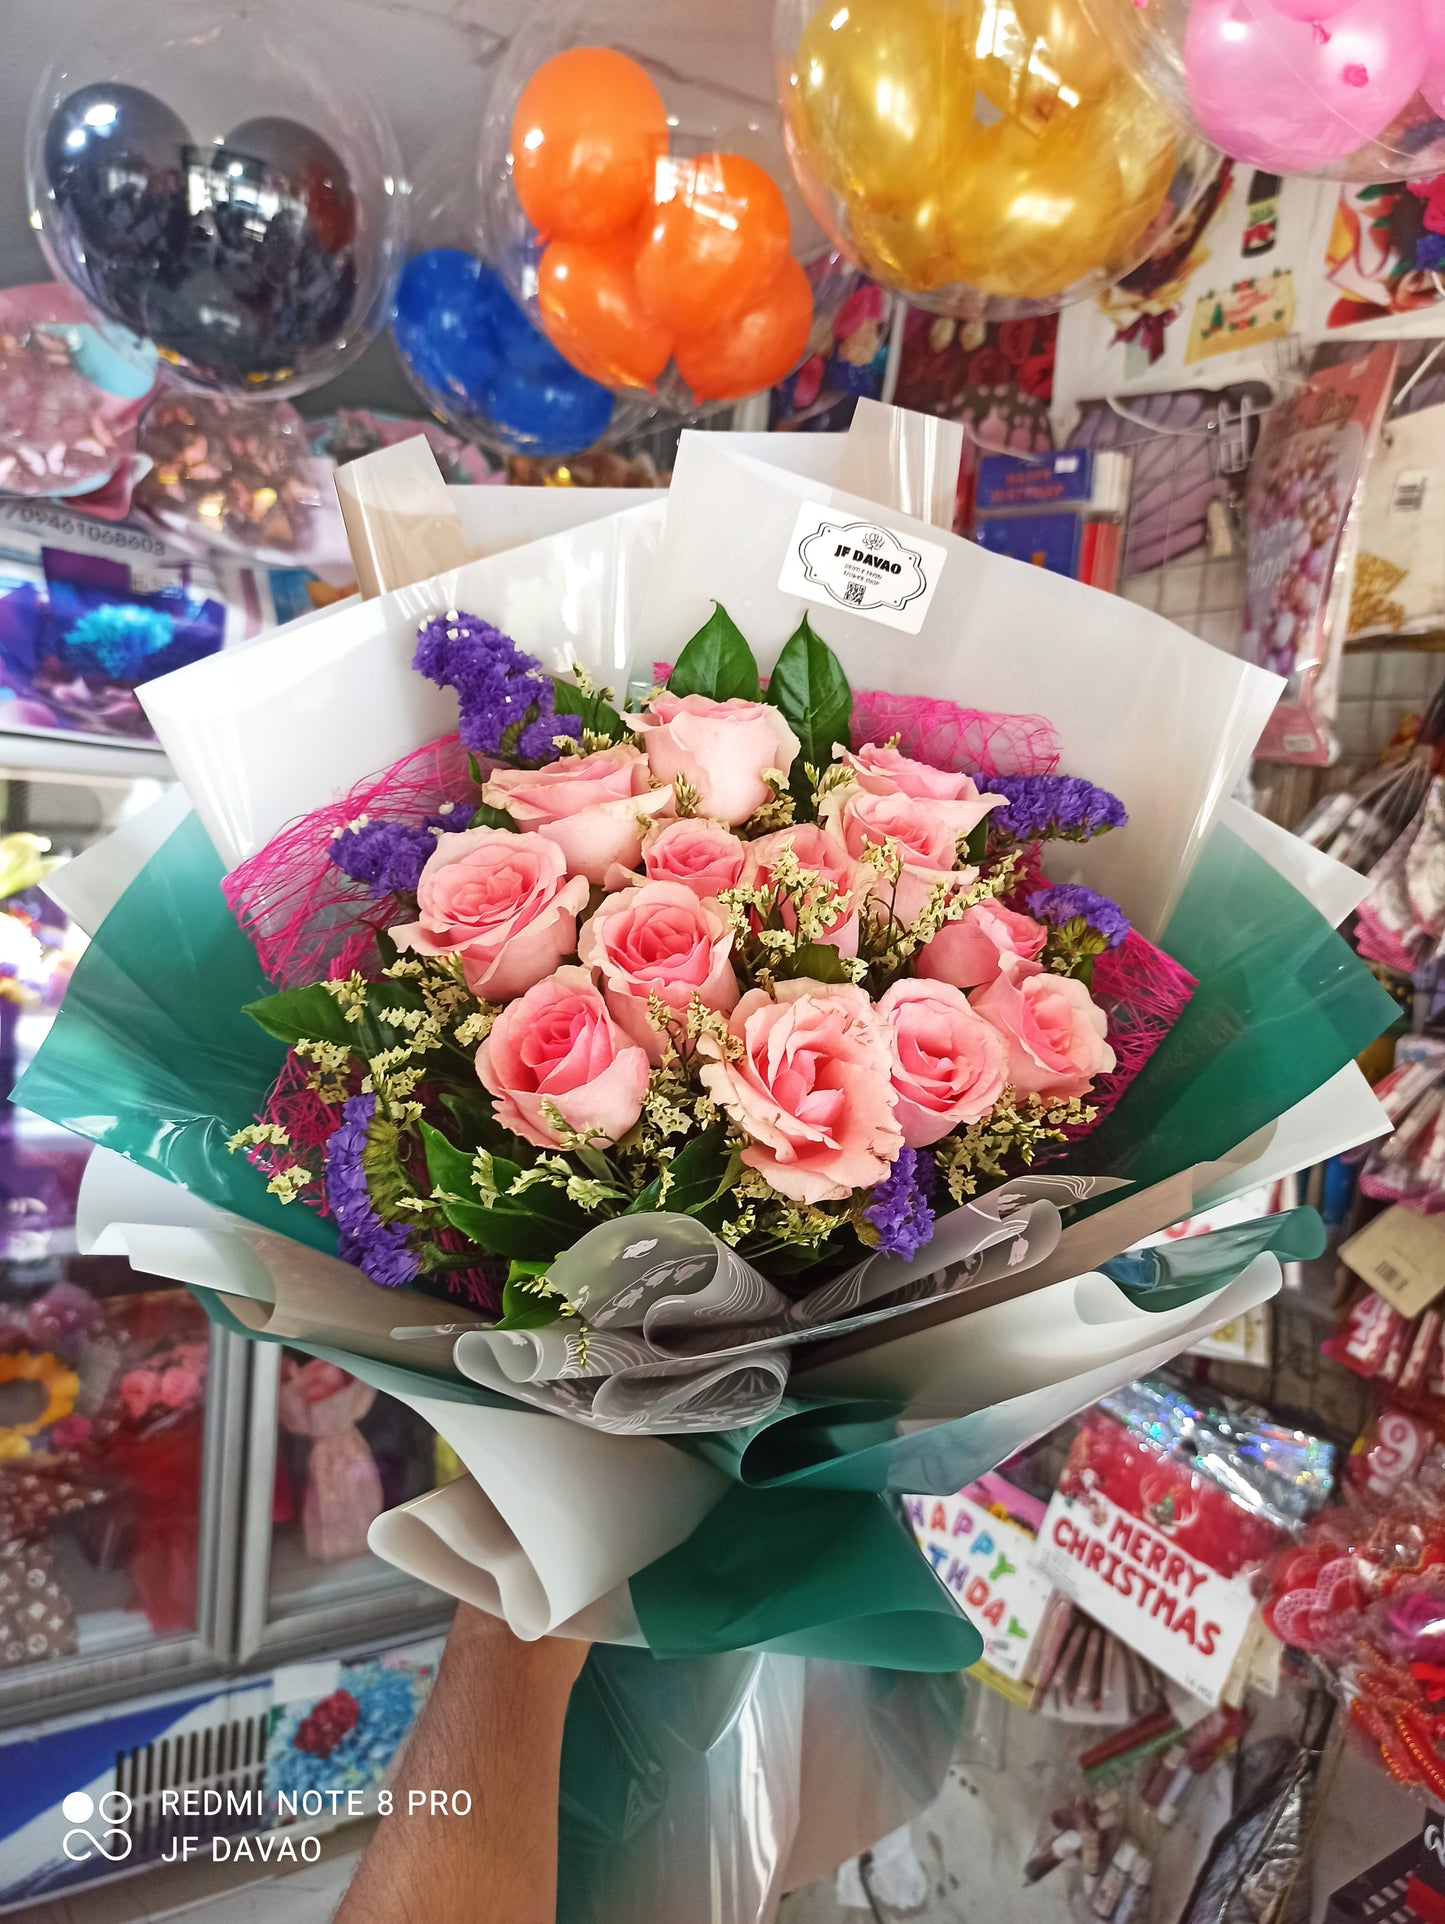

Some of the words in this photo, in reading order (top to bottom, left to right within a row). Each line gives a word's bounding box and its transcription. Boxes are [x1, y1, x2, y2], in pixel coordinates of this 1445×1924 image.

[834, 544, 851, 557] JF
[852, 549, 902, 575] DAVAO
[904, 1499, 1016, 1581] HAPPY
[1108, 1516, 1208, 1598] MERRY
[917, 1537, 1028, 1640] THDAY
[1052, 1517, 1221, 1656] CHRISTMAS
